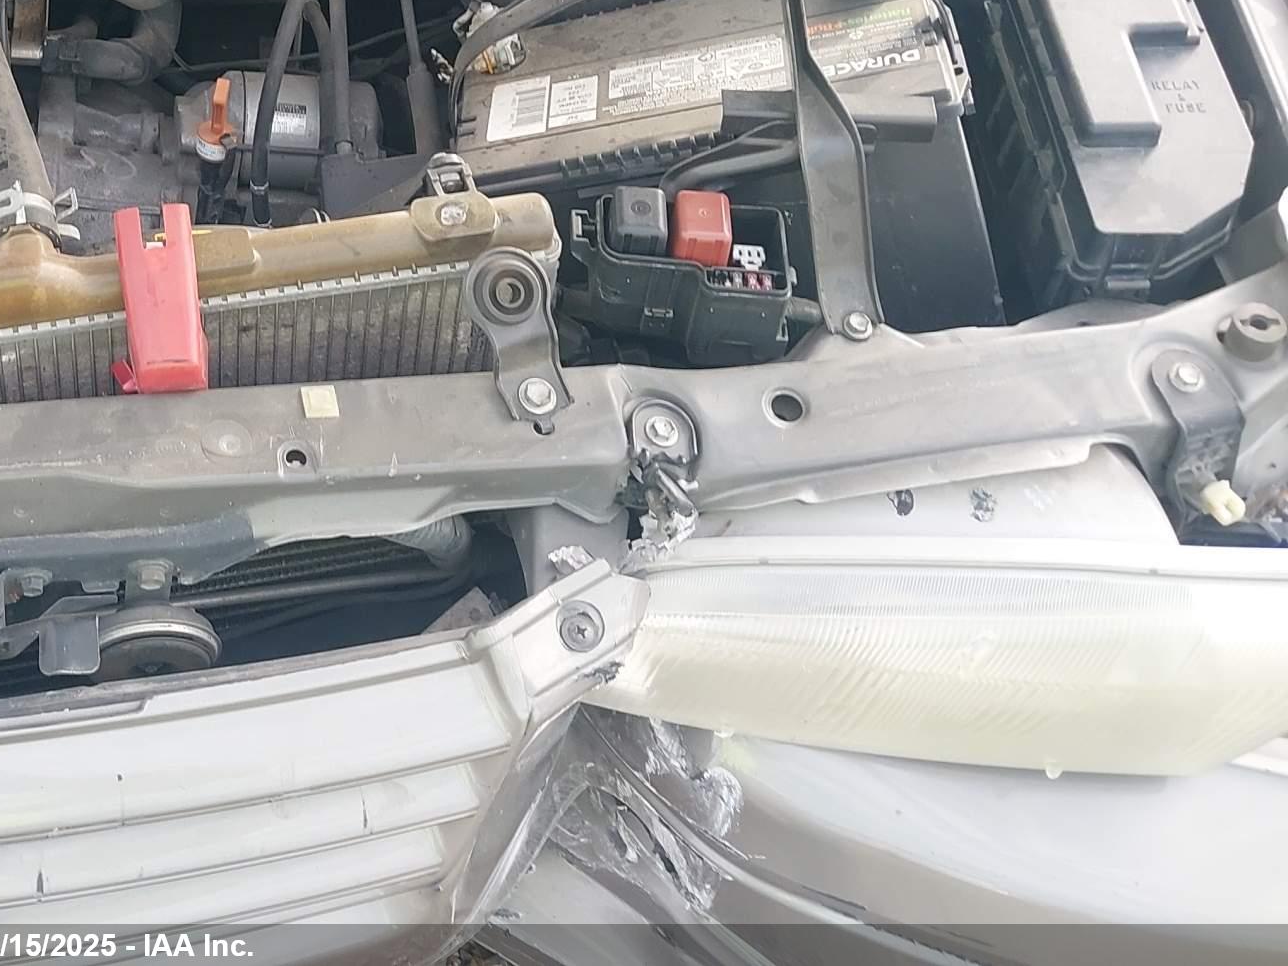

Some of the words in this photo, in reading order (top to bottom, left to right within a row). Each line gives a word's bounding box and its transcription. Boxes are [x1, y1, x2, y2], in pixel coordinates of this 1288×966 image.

[822, 49, 920, 76] DURACE
[1150, 79, 1201, 91] RELAY
[1165, 102, 1208, 113] FUSE
